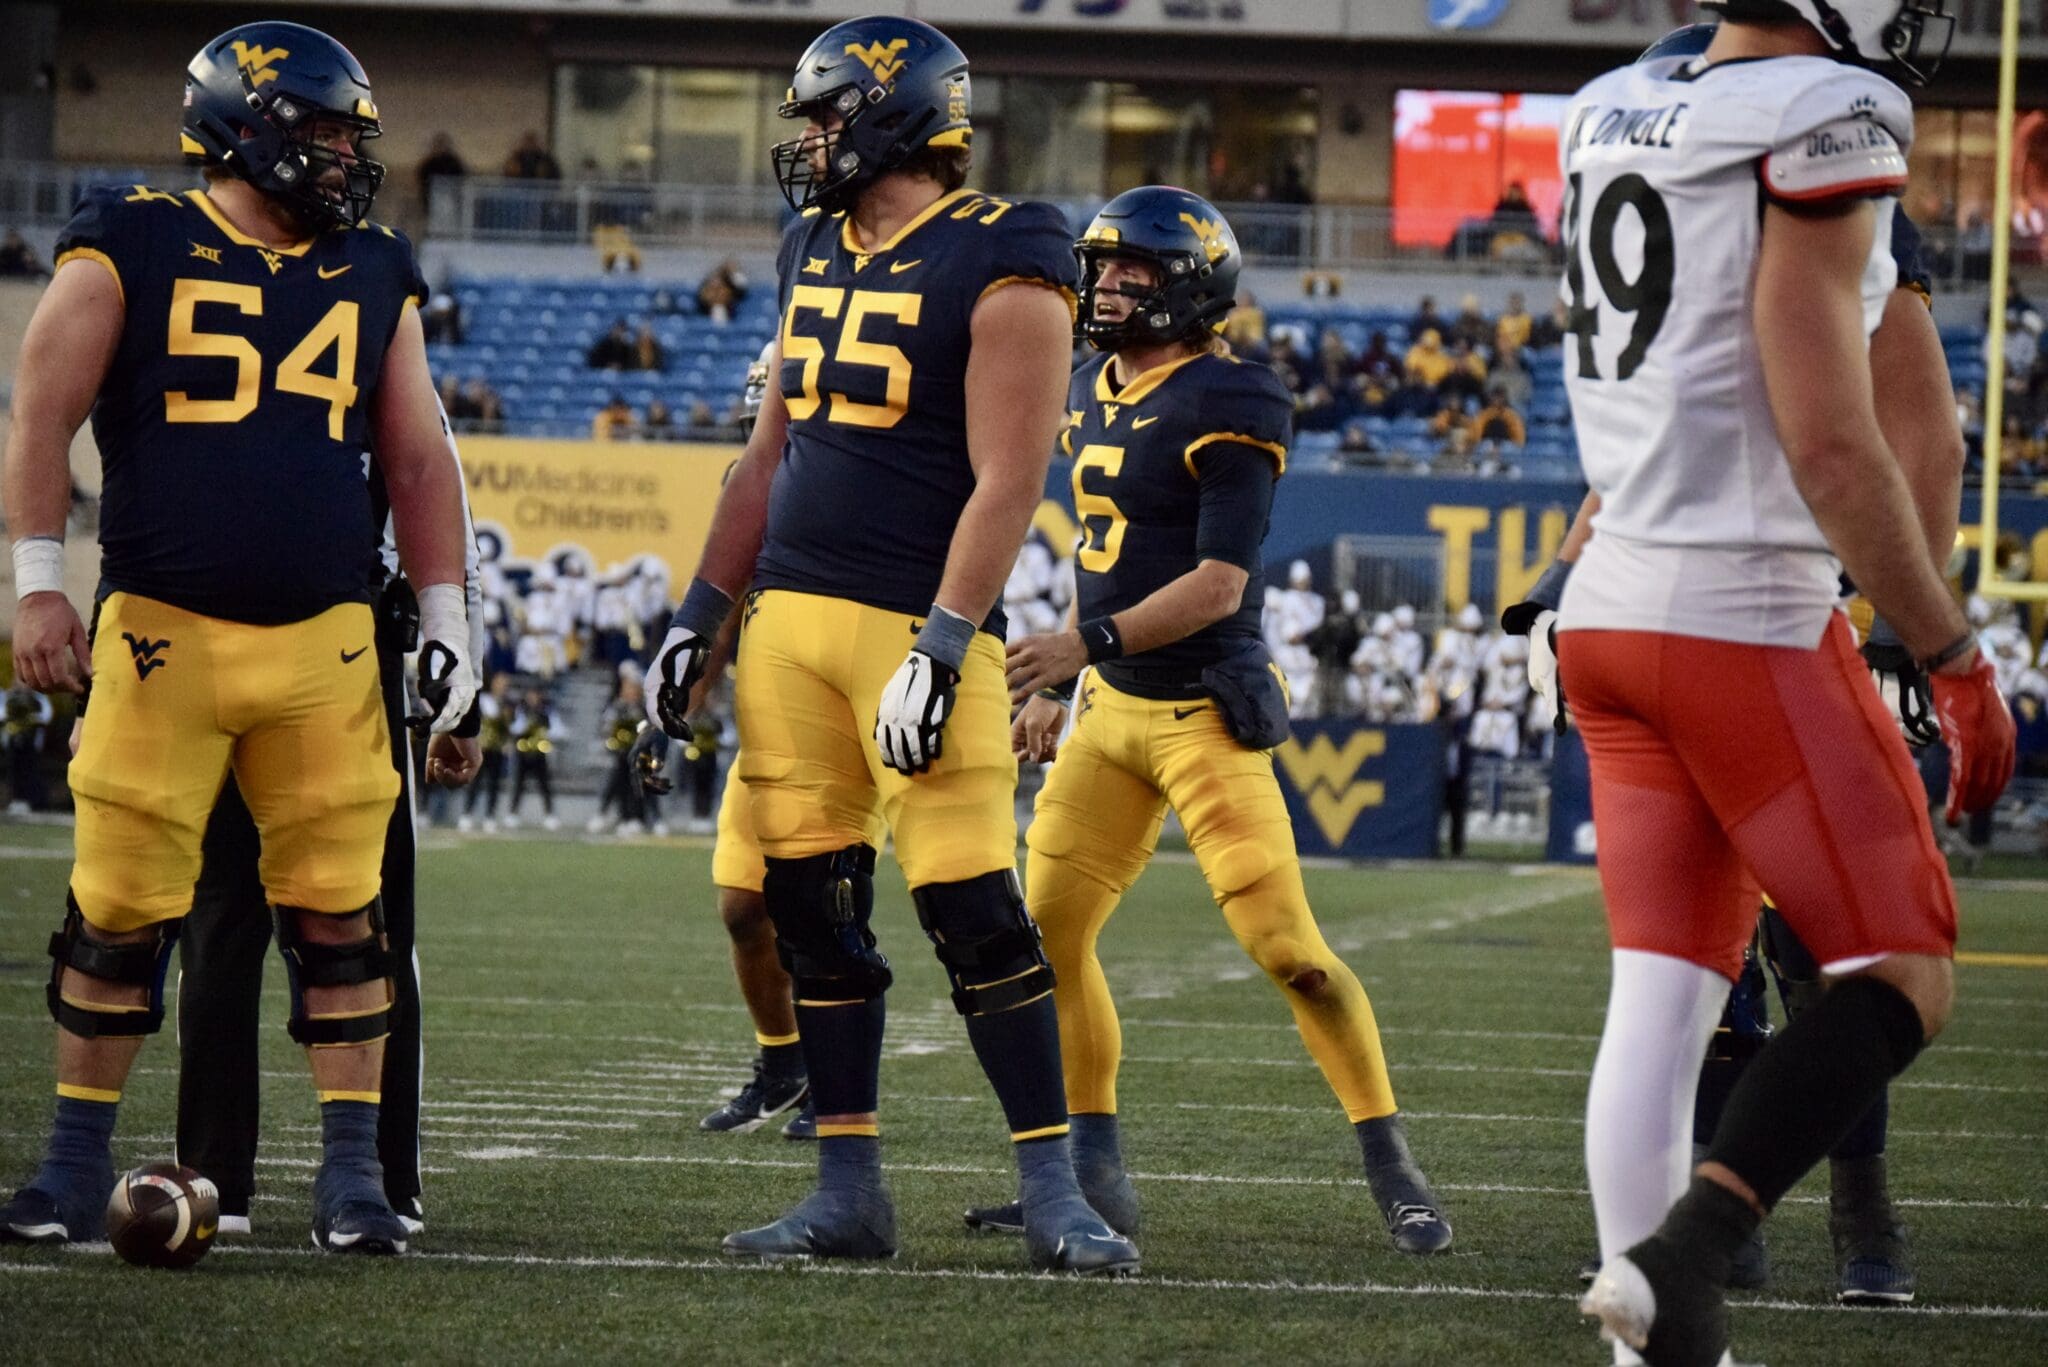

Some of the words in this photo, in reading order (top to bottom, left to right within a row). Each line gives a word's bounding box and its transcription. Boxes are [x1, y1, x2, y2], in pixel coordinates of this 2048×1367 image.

[1566, 171, 1676, 381] 49
[165, 278, 359, 441] 54
[780, 284, 922, 429] 55
[461, 459, 662, 496] VUMedicine
[1071, 444, 1128, 574] 6
